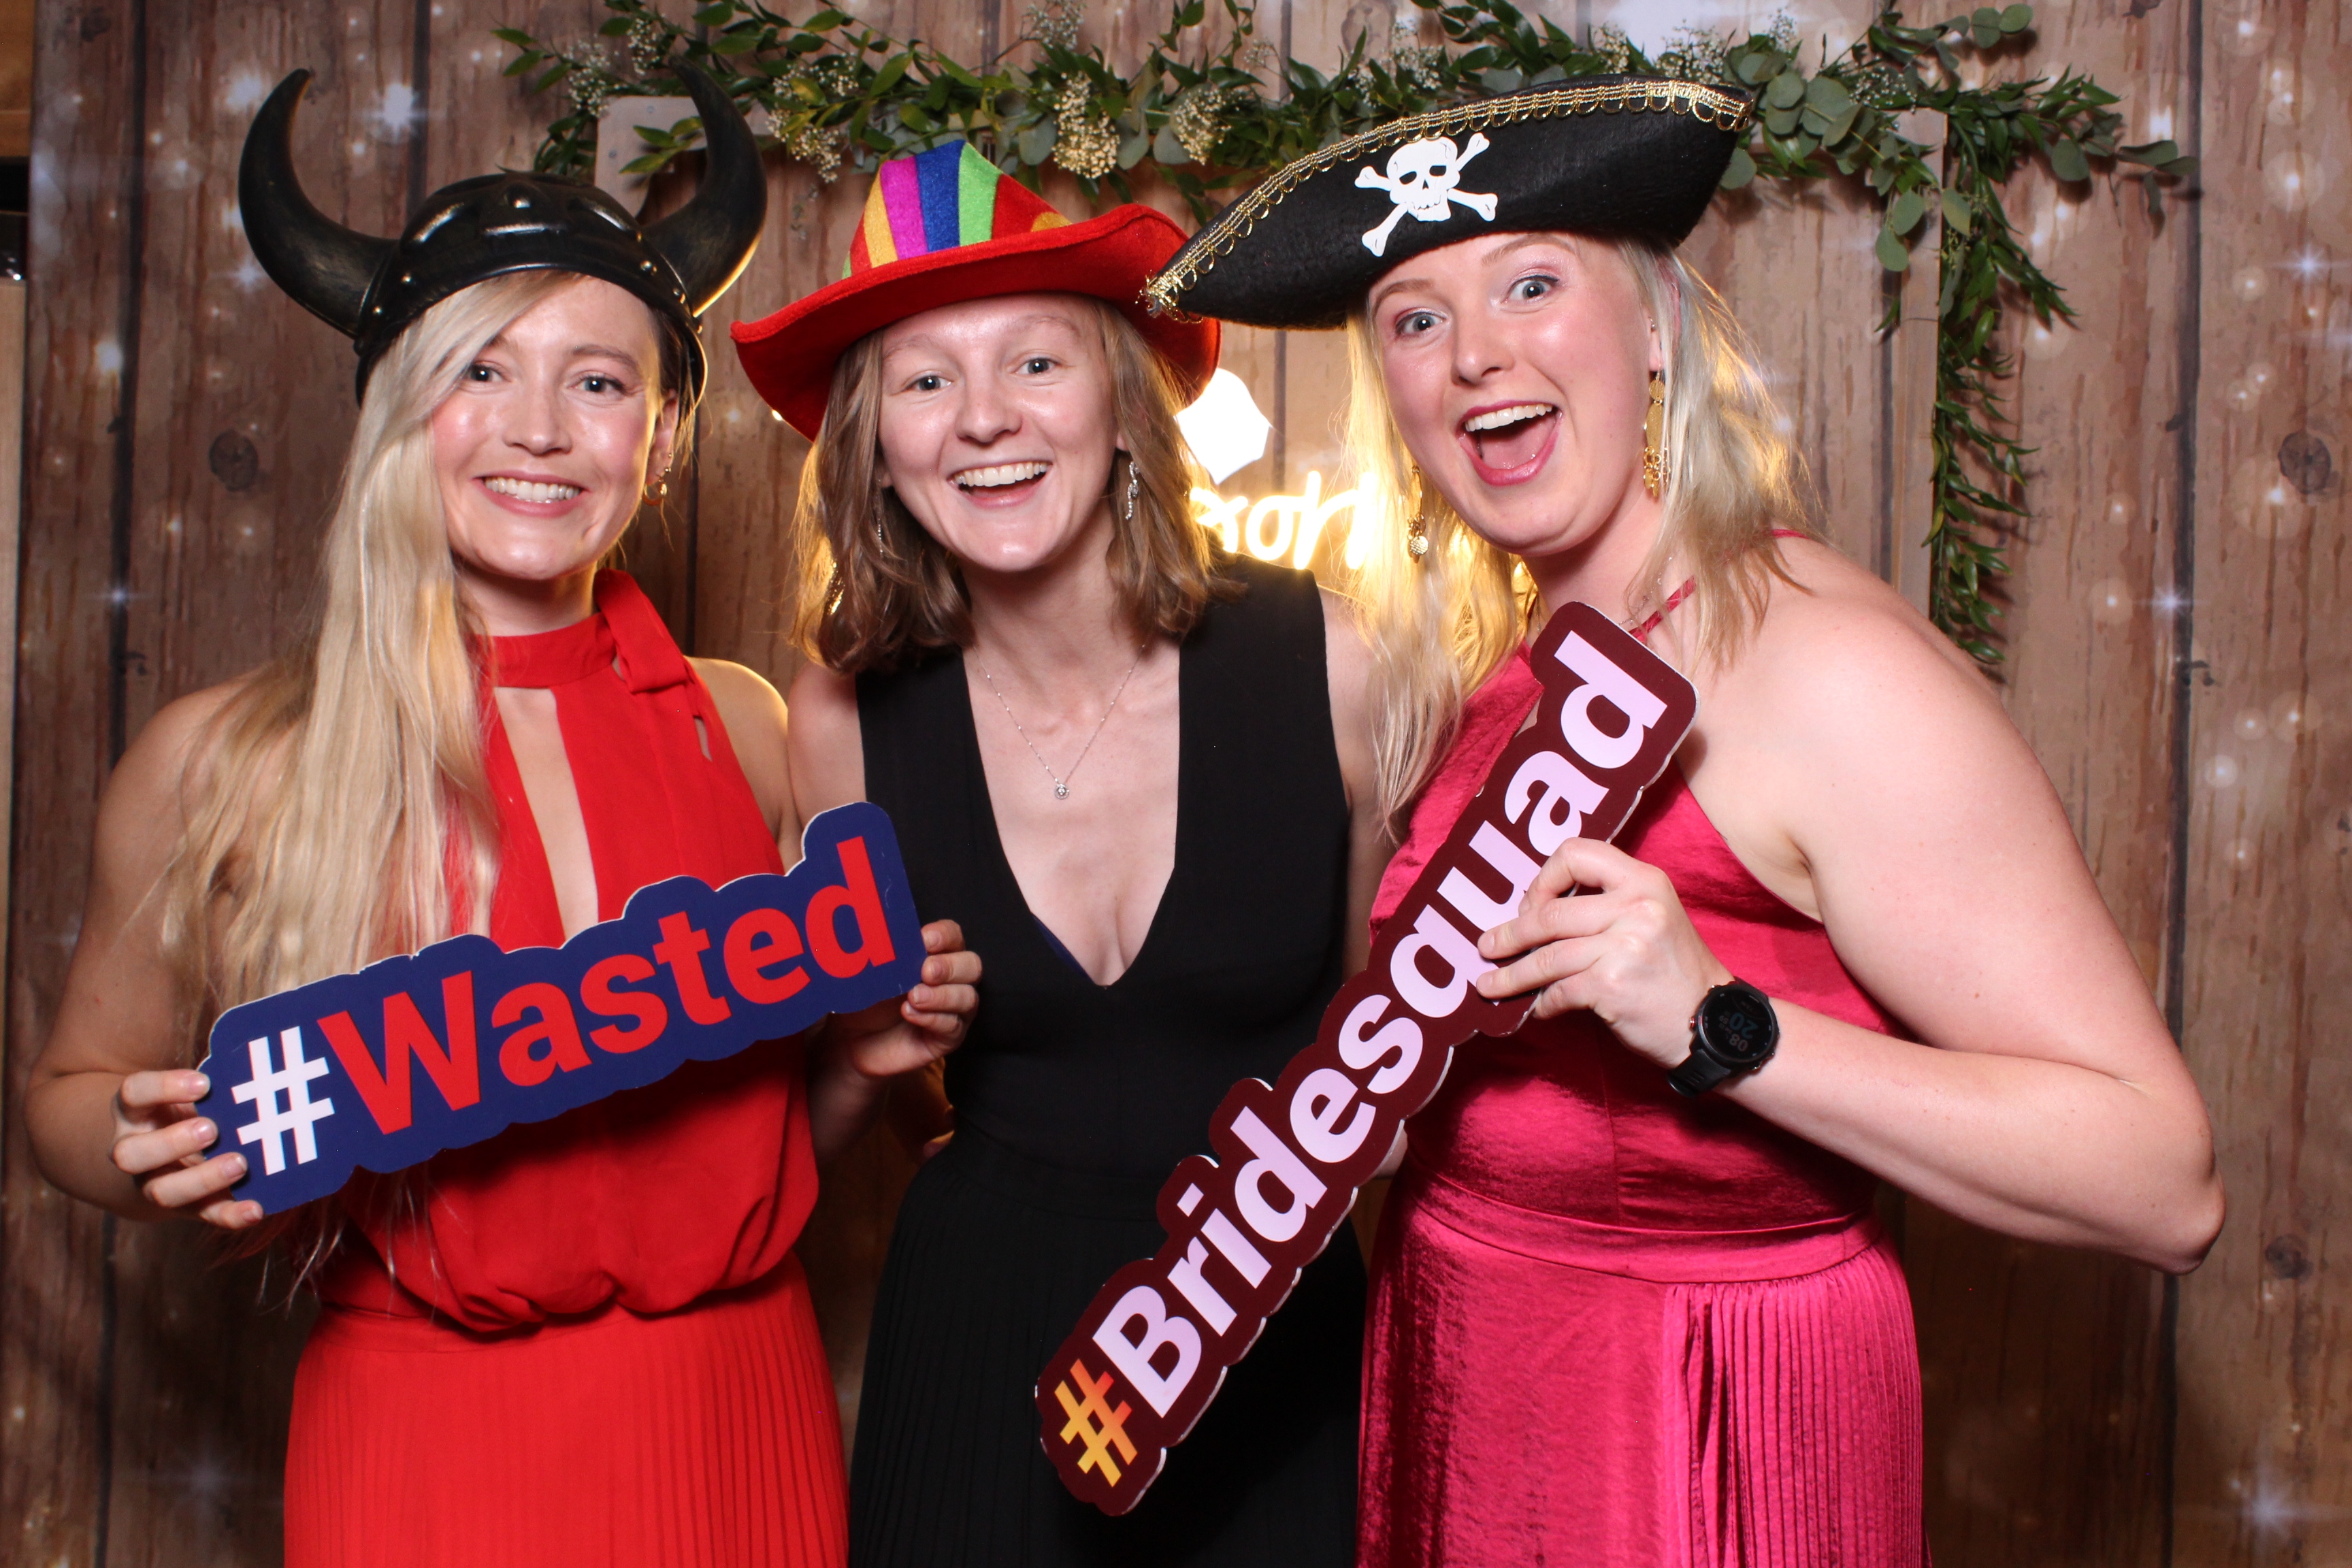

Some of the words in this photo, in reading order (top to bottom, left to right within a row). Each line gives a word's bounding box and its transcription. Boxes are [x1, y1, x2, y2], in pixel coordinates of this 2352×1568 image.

[231, 836, 896, 1175] #Wasted
[1055, 630, 1667, 1488] #Bridesquad
[1729, 1033, 1749, 1052] 08
